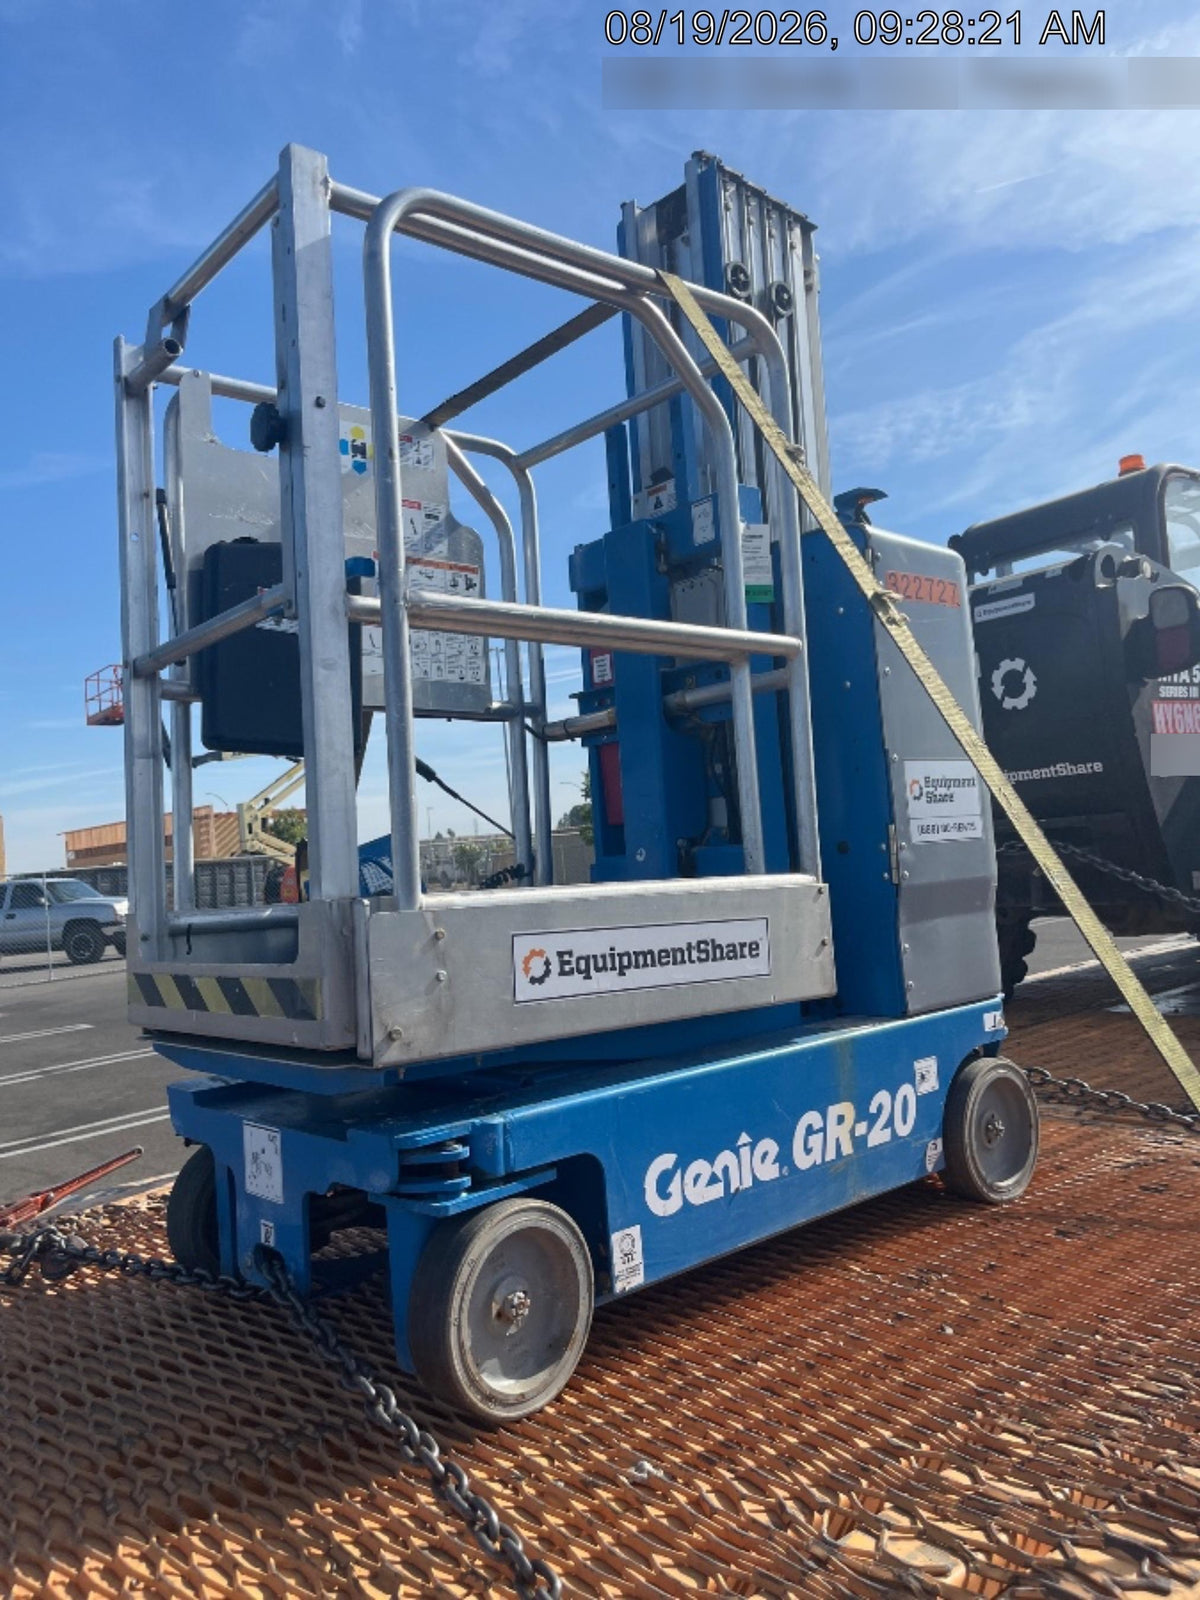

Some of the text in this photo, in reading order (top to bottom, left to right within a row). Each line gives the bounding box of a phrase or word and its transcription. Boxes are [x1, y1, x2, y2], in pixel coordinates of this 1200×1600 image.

[888, 572, 957, 604] 322727
[1159, 686, 1188, 698] SERIES
[924, 776, 976, 791] Equipment
[1004, 761, 1103, 785] ipmentShare
[925, 790, 955, 804] Share
[556, 938, 761, 981] EquipmentShare
[644, 1083, 917, 1218] Genie GR-20
